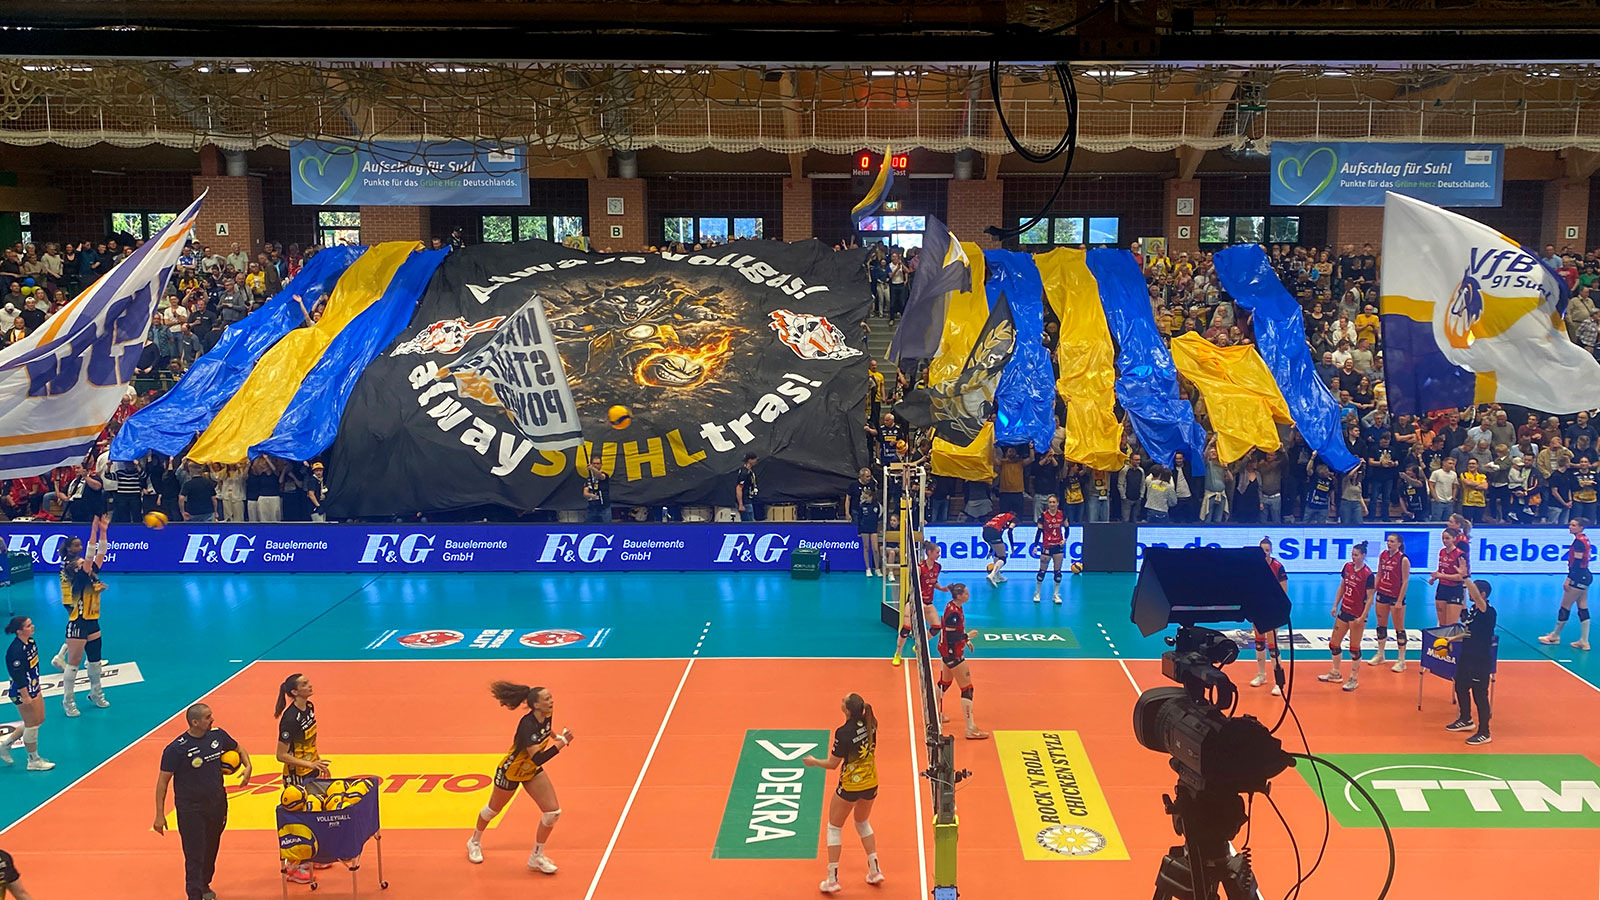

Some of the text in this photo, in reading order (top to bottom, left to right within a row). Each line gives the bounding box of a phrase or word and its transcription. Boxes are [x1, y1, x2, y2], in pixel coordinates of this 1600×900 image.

[362, 160, 476, 176] Aufschlag für Suhl
[1340, 162, 1452, 177] Aufschlag für Suhl
[363, 178, 518, 188] Punkte für das Grüne Herz Deutschlands.
[1340, 180, 1367, 188] Punkte
[1367, 179, 1379, 188] für
[1380, 180, 1394, 188] das
[1438, 179, 1491, 188] Deutschlands.
[218, 224, 227, 235] A
[612, 226, 621, 237] B
[1180, 227, 1189, 238] C
[1567, 228, 1577, 238] D
[1471, 247, 1538, 280] VfB
[1491, 275, 1512, 288] 91
[179, 533, 328, 564] F&G Bauelemente
[358, 533, 508, 564] F&G Bauelemente
[536, 533, 685, 564] F&G Bauelemente
[713, 533, 860, 563] F&G Bauelemente
[1279, 538, 1354, 560] SHT
[263, 552, 295, 562] GmbH
[442, 552, 474, 562] GmbH
[621, 552, 652, 562] GmbH
[983, 633, 1067, 642] DEKRA
[1021, 749, 1046, 777] ROLL
[745, 767, 805, 844] DEKRA
[1033, 790, 1061, 824] ROCK
